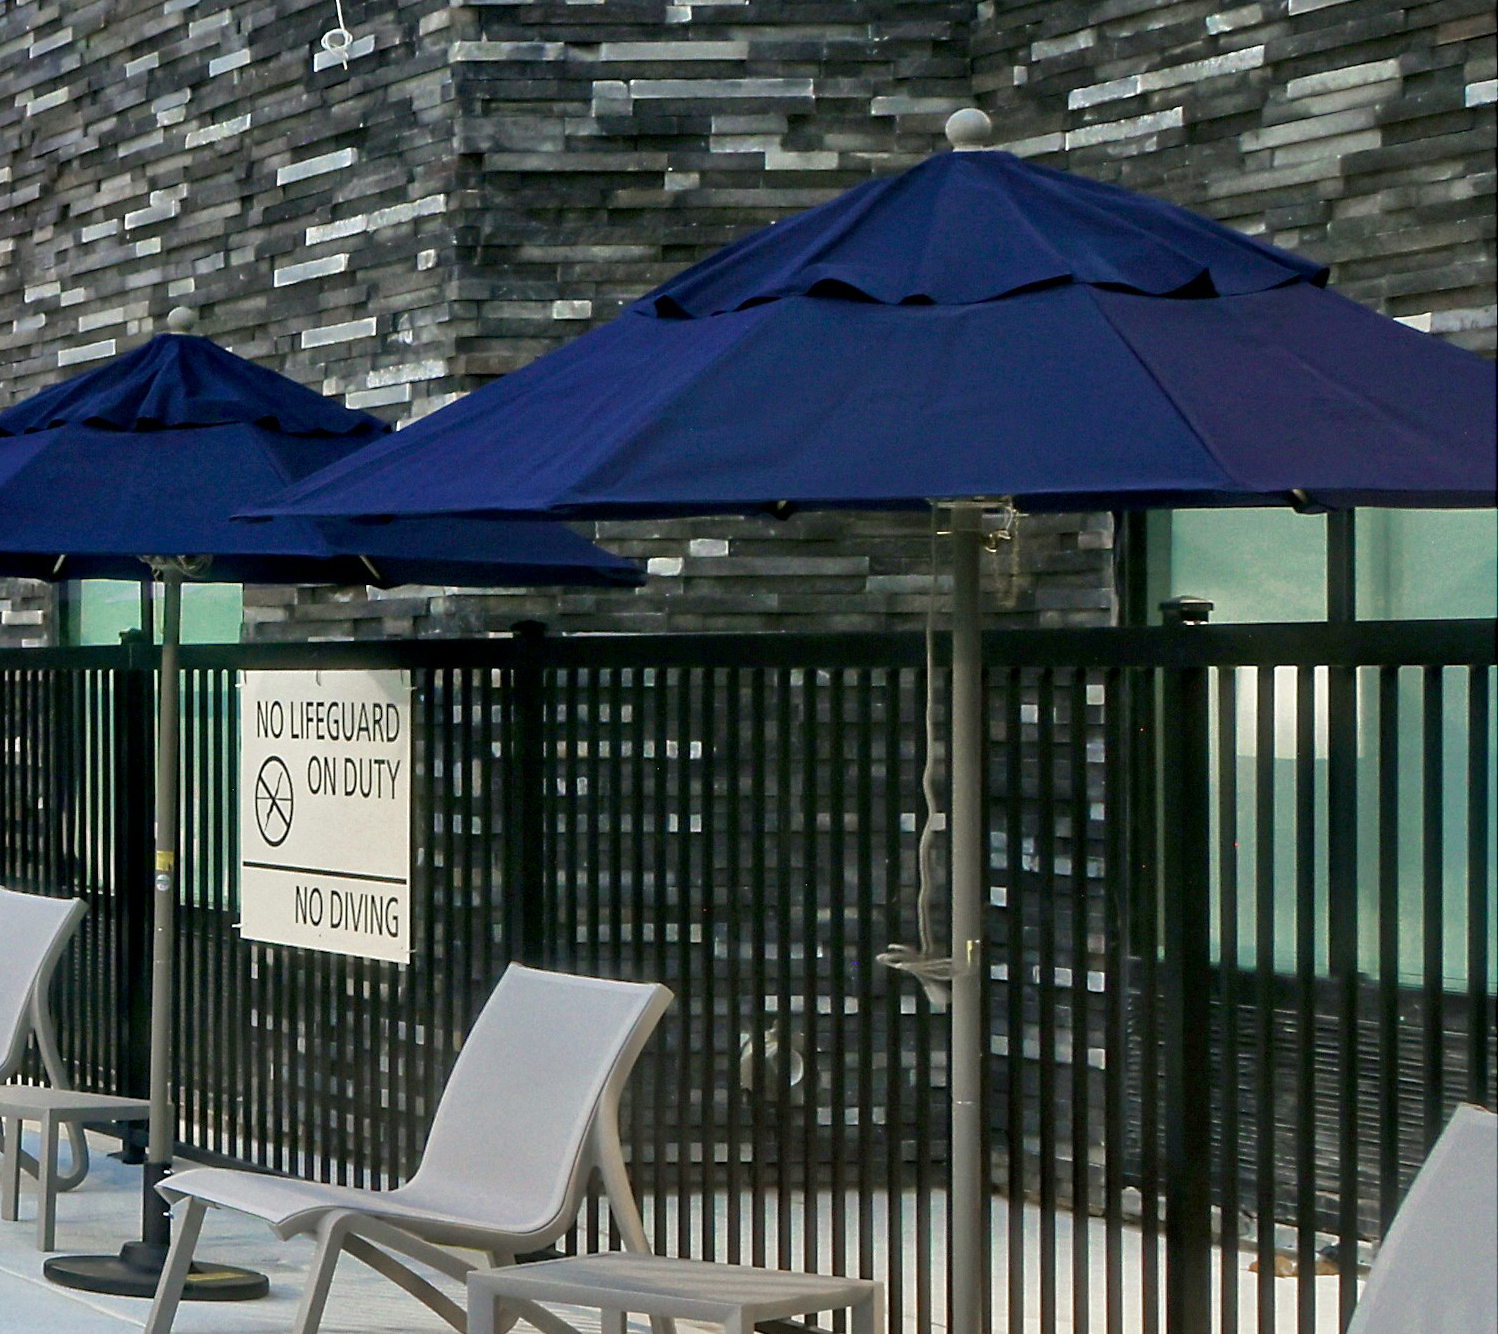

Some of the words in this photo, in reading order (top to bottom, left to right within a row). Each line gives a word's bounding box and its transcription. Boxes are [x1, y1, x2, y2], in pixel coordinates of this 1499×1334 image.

[257, 700, 283, 738] NO
[291, 701, 399, 742] LIFEGUARD
[308, 755, 336, 795] ON
[344, 757, 400, 799] DUTY
[295, 885, 323, 927] NO
[330, 890, 398, 938] DIVING
